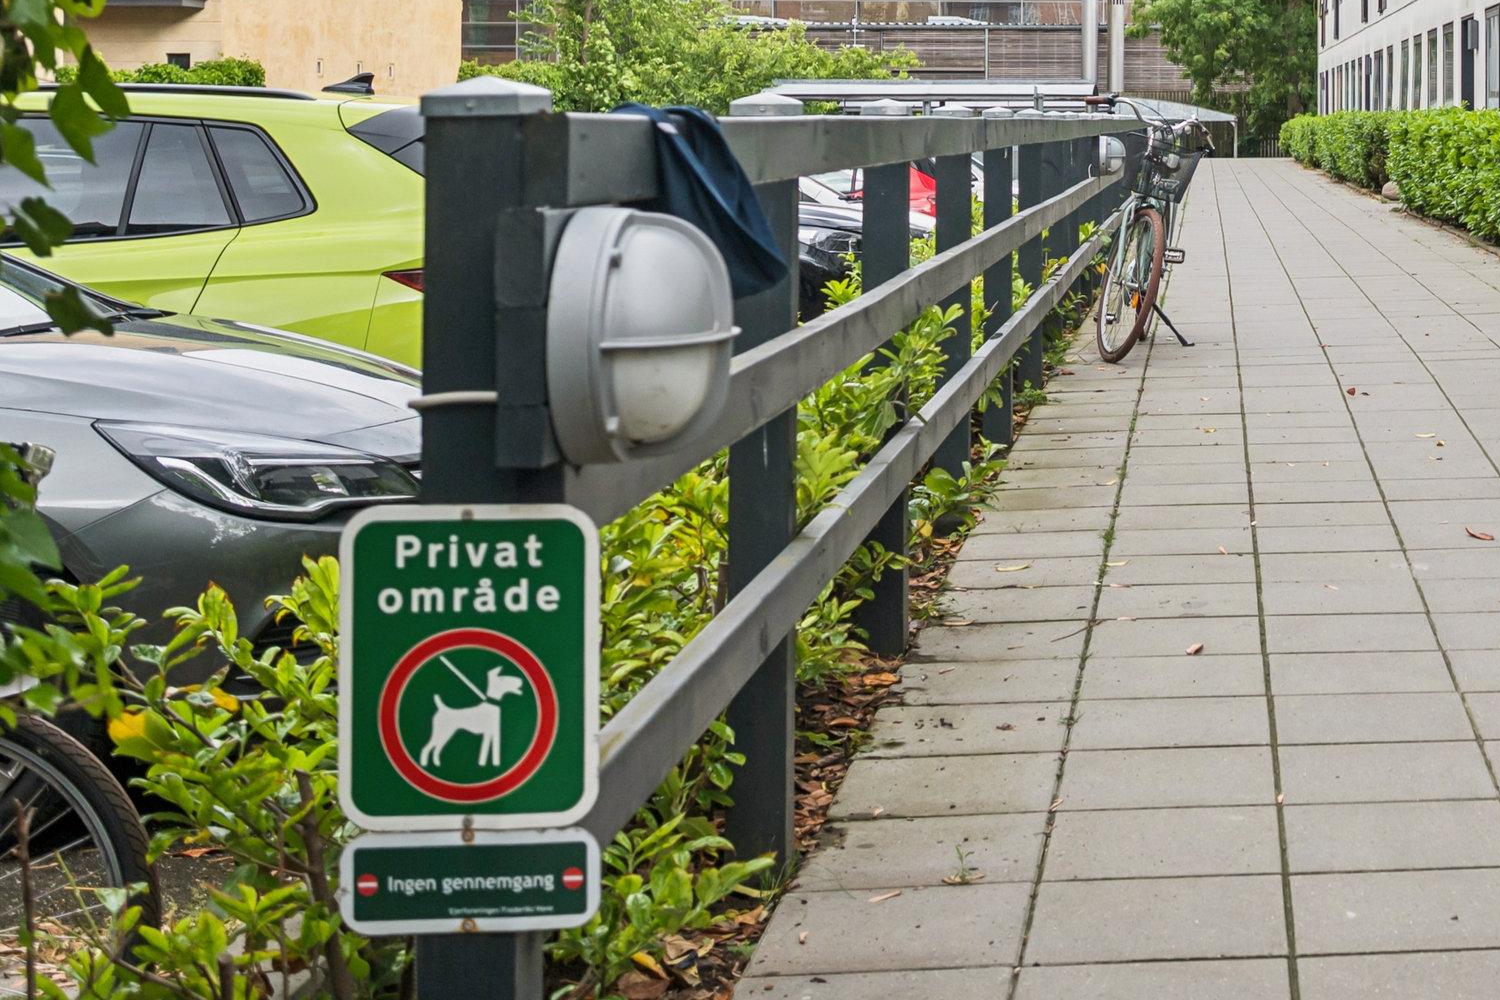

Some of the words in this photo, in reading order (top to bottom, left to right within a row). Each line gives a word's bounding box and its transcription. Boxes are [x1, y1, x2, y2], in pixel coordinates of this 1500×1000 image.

[395, 534, 543, 569] Privat
[377, 577, 561, 614] område
[386, 876, 437, 896] Ingen
[442, 874, 555, 895] gennemgang
